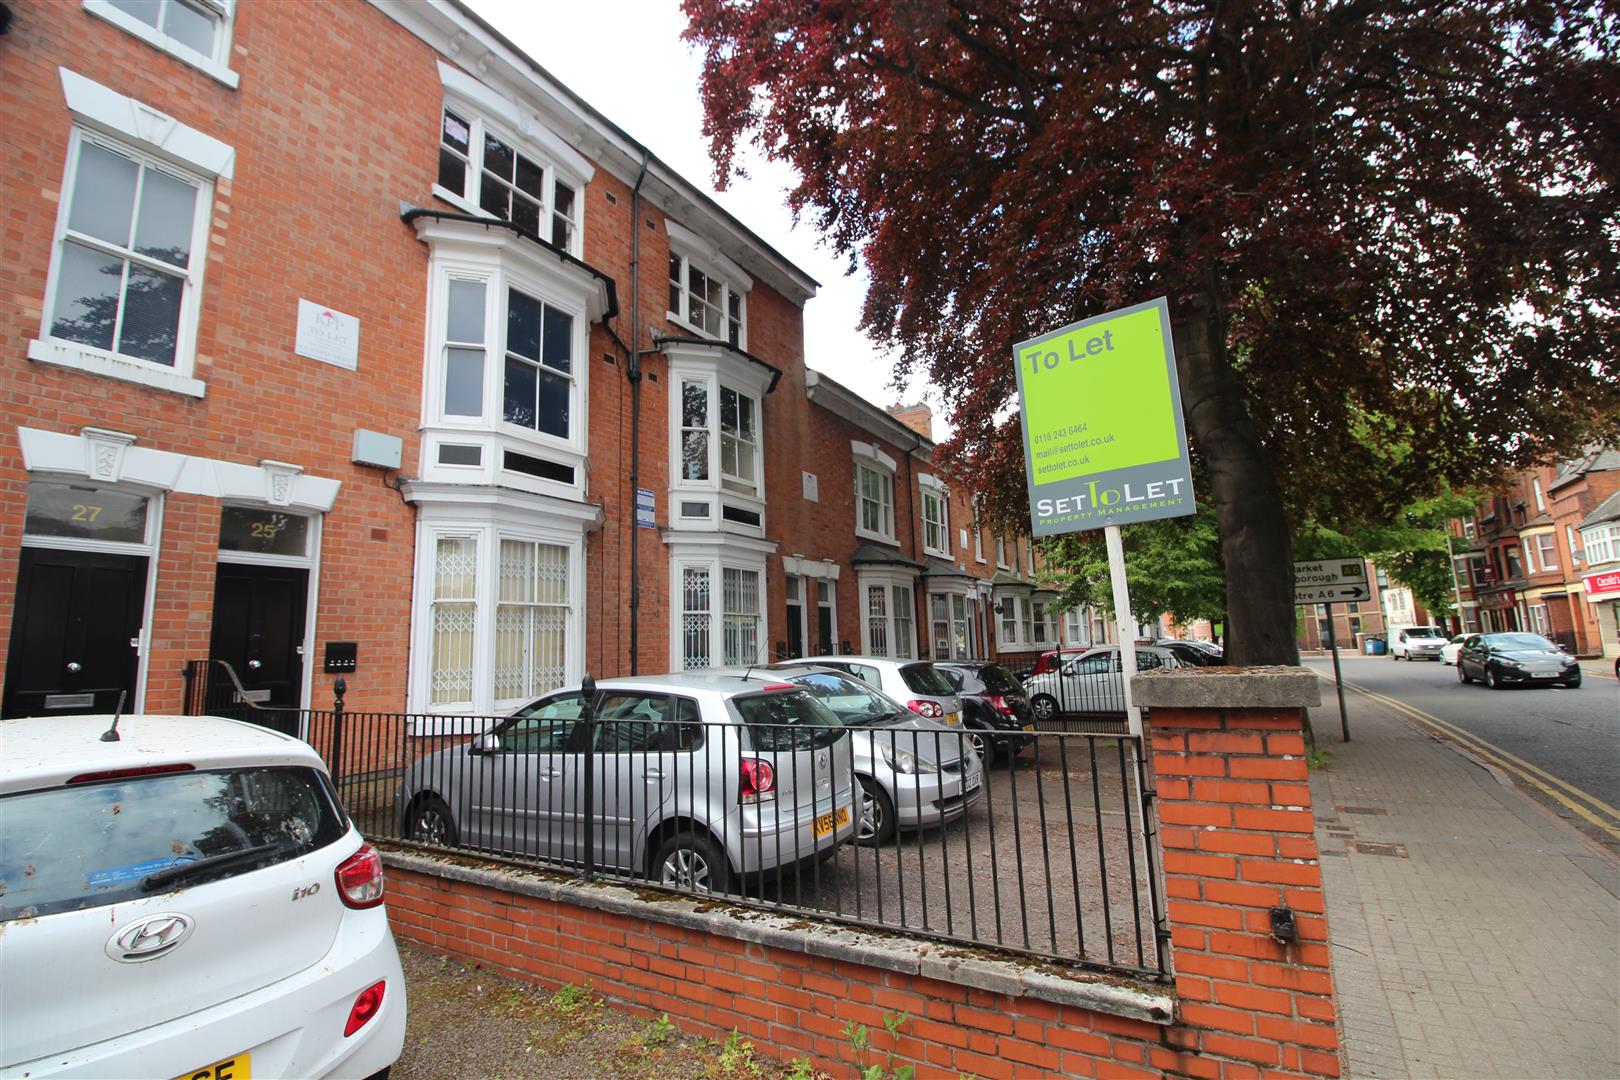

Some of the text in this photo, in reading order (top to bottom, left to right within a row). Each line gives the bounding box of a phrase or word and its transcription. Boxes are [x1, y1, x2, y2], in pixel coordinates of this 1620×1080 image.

[308, 326, 325, 336] TO
[1026, 329, 1115, 375] To Let
[1034, 422, 1088, 445] 0116 243 6464
[1036, 433, 1115, 459] mail@settolet.co.uk
[1038, 455, 1090, 475] settolet.co.uk
[71, 503, 103, 523] 27
[1039, 497, 1184, 526] PROPERTY MANAGEMENT
[251, 522, 277, 539] 25
[1294, 573, 1338, 583] borough
[1295, 564, 1360, 575] arket A6
[1318, 590, 1335, 599] A6
[291, 882, 321, 901] i10
